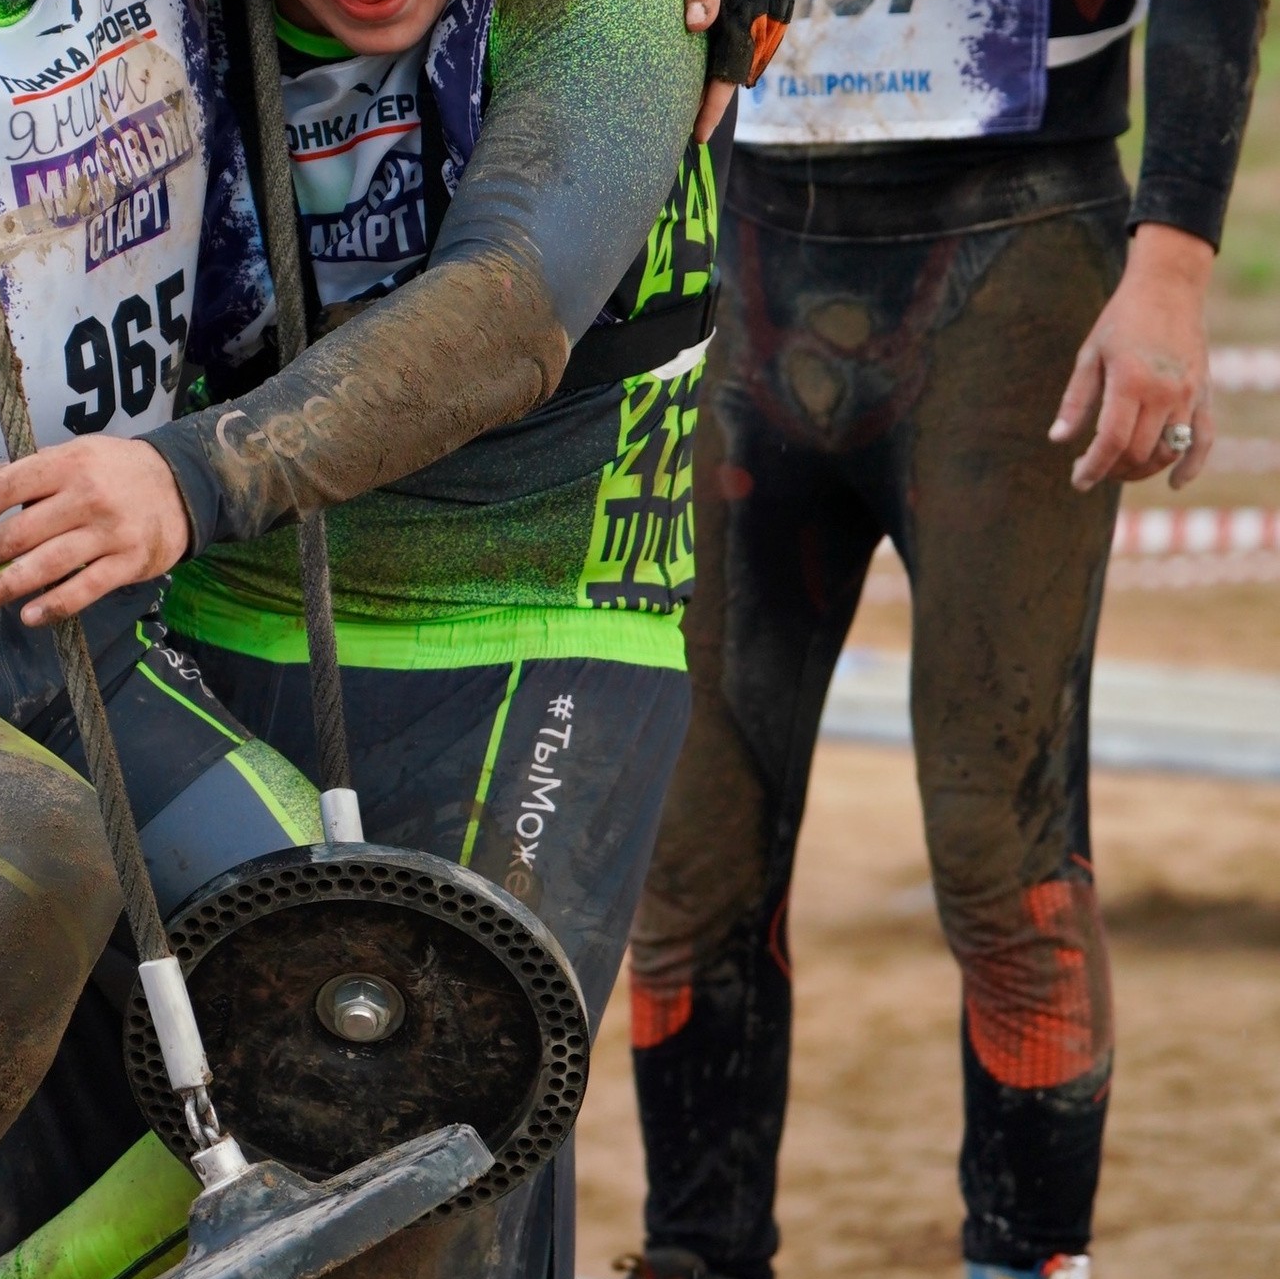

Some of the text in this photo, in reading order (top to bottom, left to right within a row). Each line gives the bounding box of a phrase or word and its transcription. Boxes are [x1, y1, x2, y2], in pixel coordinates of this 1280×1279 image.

[0, 1, 152, 95] ГОНКА ГРОЕВ
[285, 113, 358, 152] ОНКА
[89, 181, 162, 262] СТАРТ
[63, 269, 187, 435] 965
